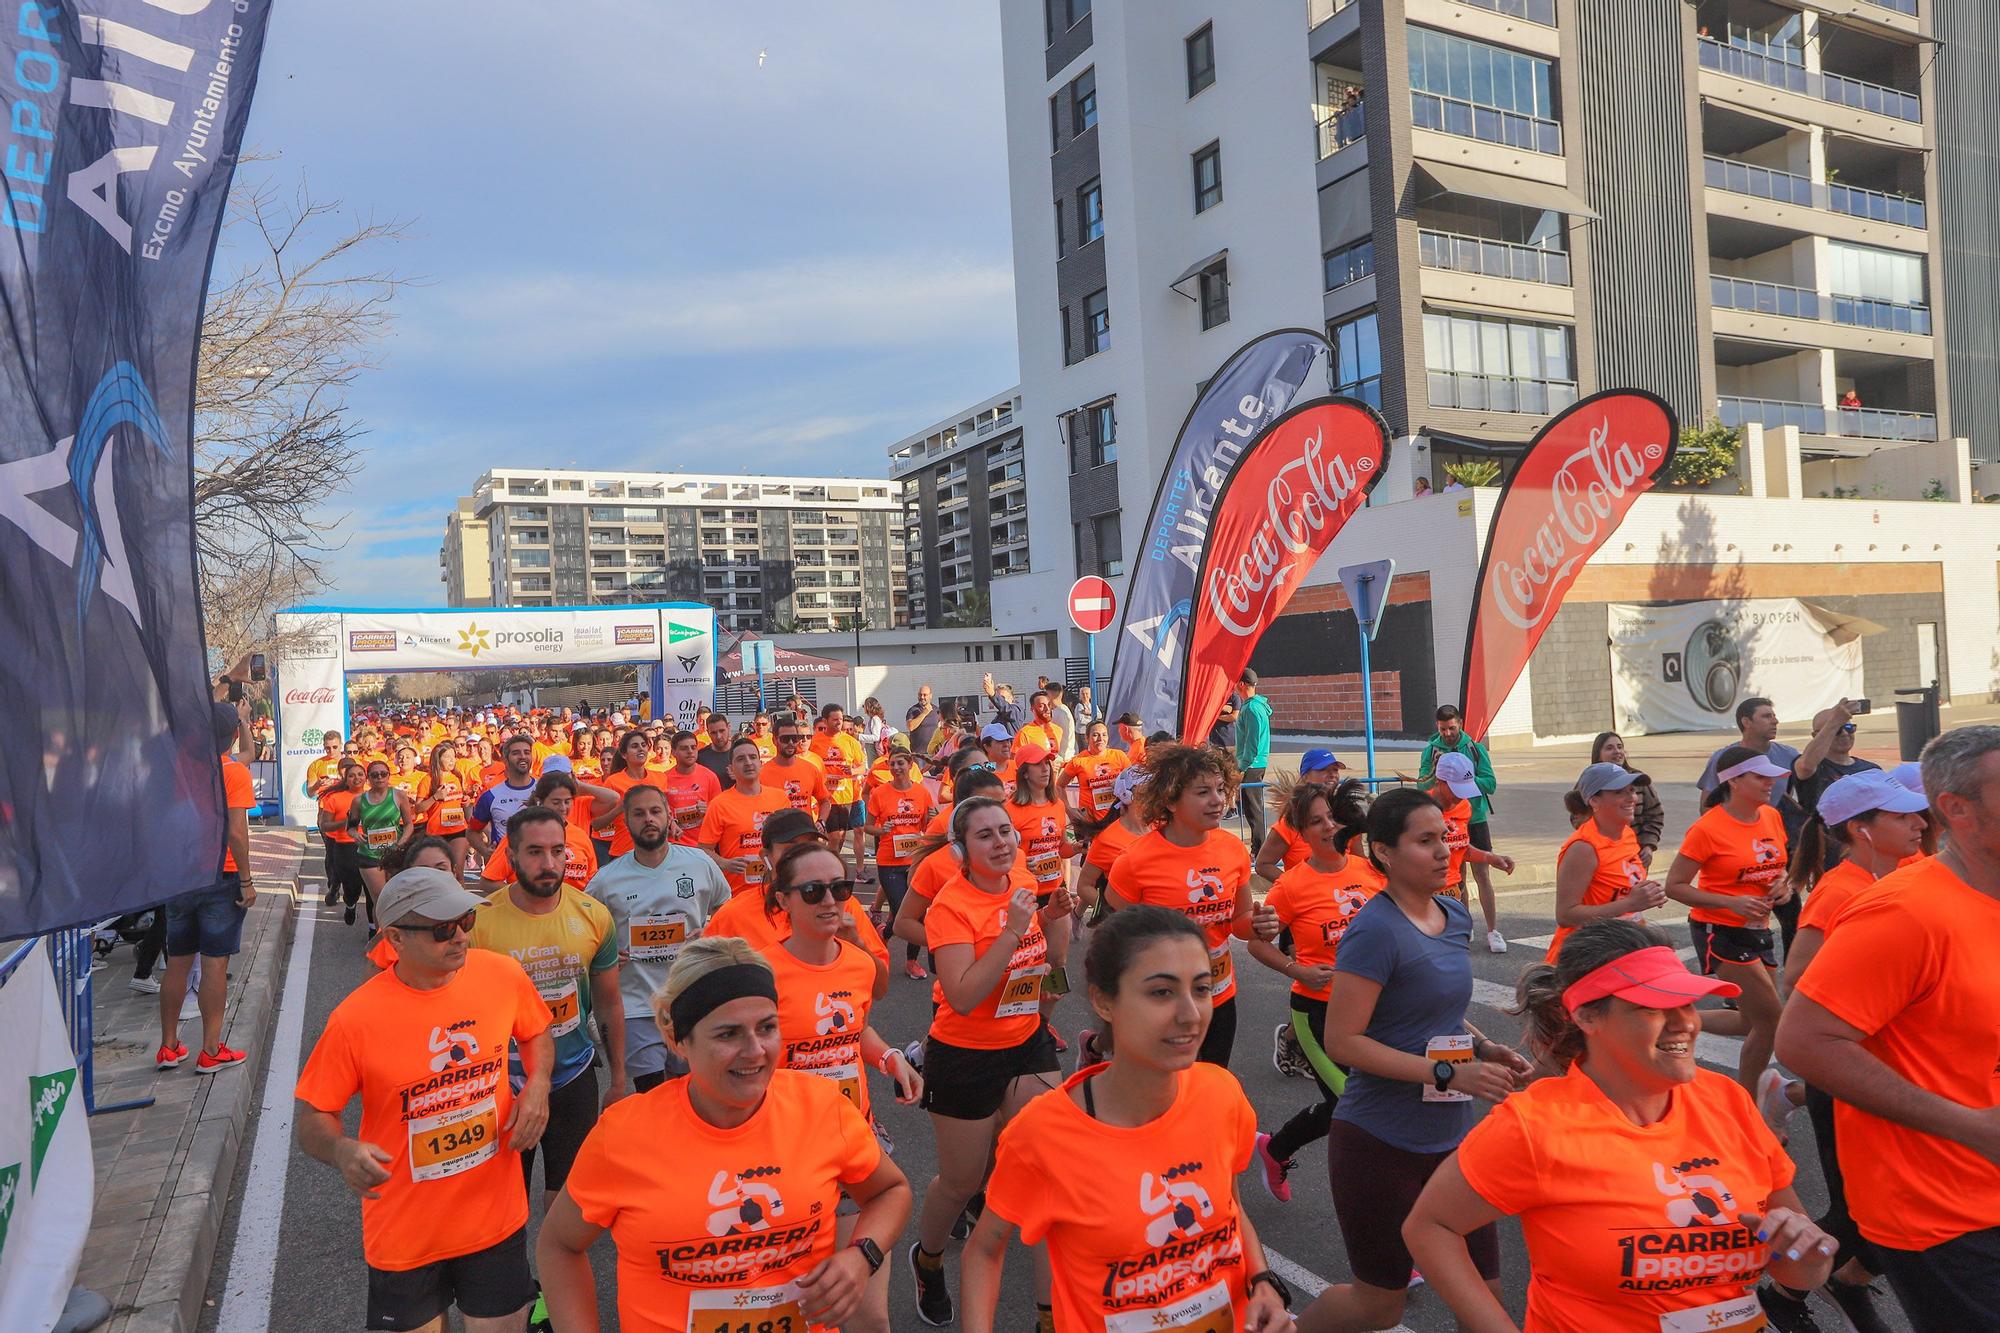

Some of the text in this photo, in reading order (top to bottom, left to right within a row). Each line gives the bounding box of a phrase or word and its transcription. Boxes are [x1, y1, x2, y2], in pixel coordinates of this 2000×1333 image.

[67, 0, 212, 256] Ali
[141, 187, 189, 260] Excmo.
[172, 23, 244, 179] Ayuntamiento
[1171, 394, 1265, 575] Alicante
[1151, 468, 1191, 561] DEPORTES
[495, 628, 564, 648] prosolia
[534, 643, 563, 653] energy
[775, 663, 831, 674] deport.es
[679, 699, 696, 711] Oh
[677, 721, 696, 731] Cut
[679, 713, 696, 722] my
[1037, 860, 1058, 872] 1007
[640, 928, 675, 942] 1237
[527, 945, 561, 959] Gran
[522, 953, 581, 972] arrera del
[1010, 982, 1034, 998] 1106
[410, 1057, 503, 1097] CARRERA
[409, 1072, 501, 1111] PROSOLIA
[401, 1098, 460, 1122] ALICANTE
[428, 1124, 485, 1155] 1349
[441, 1155, 464, 1167] equipo
[671, 1218, 821, 1261] CARRERA
[1118, 1216, 1237, 1279] CARRERA
[661, 1269, 748, 1283] ALICANTE
[1115, 1235, 1242, 1299] PROSOLIA
[1618, 1274, 1718, 1291] ALICANTE
[1103, 1277, 1186, 1310] ALICANTE
